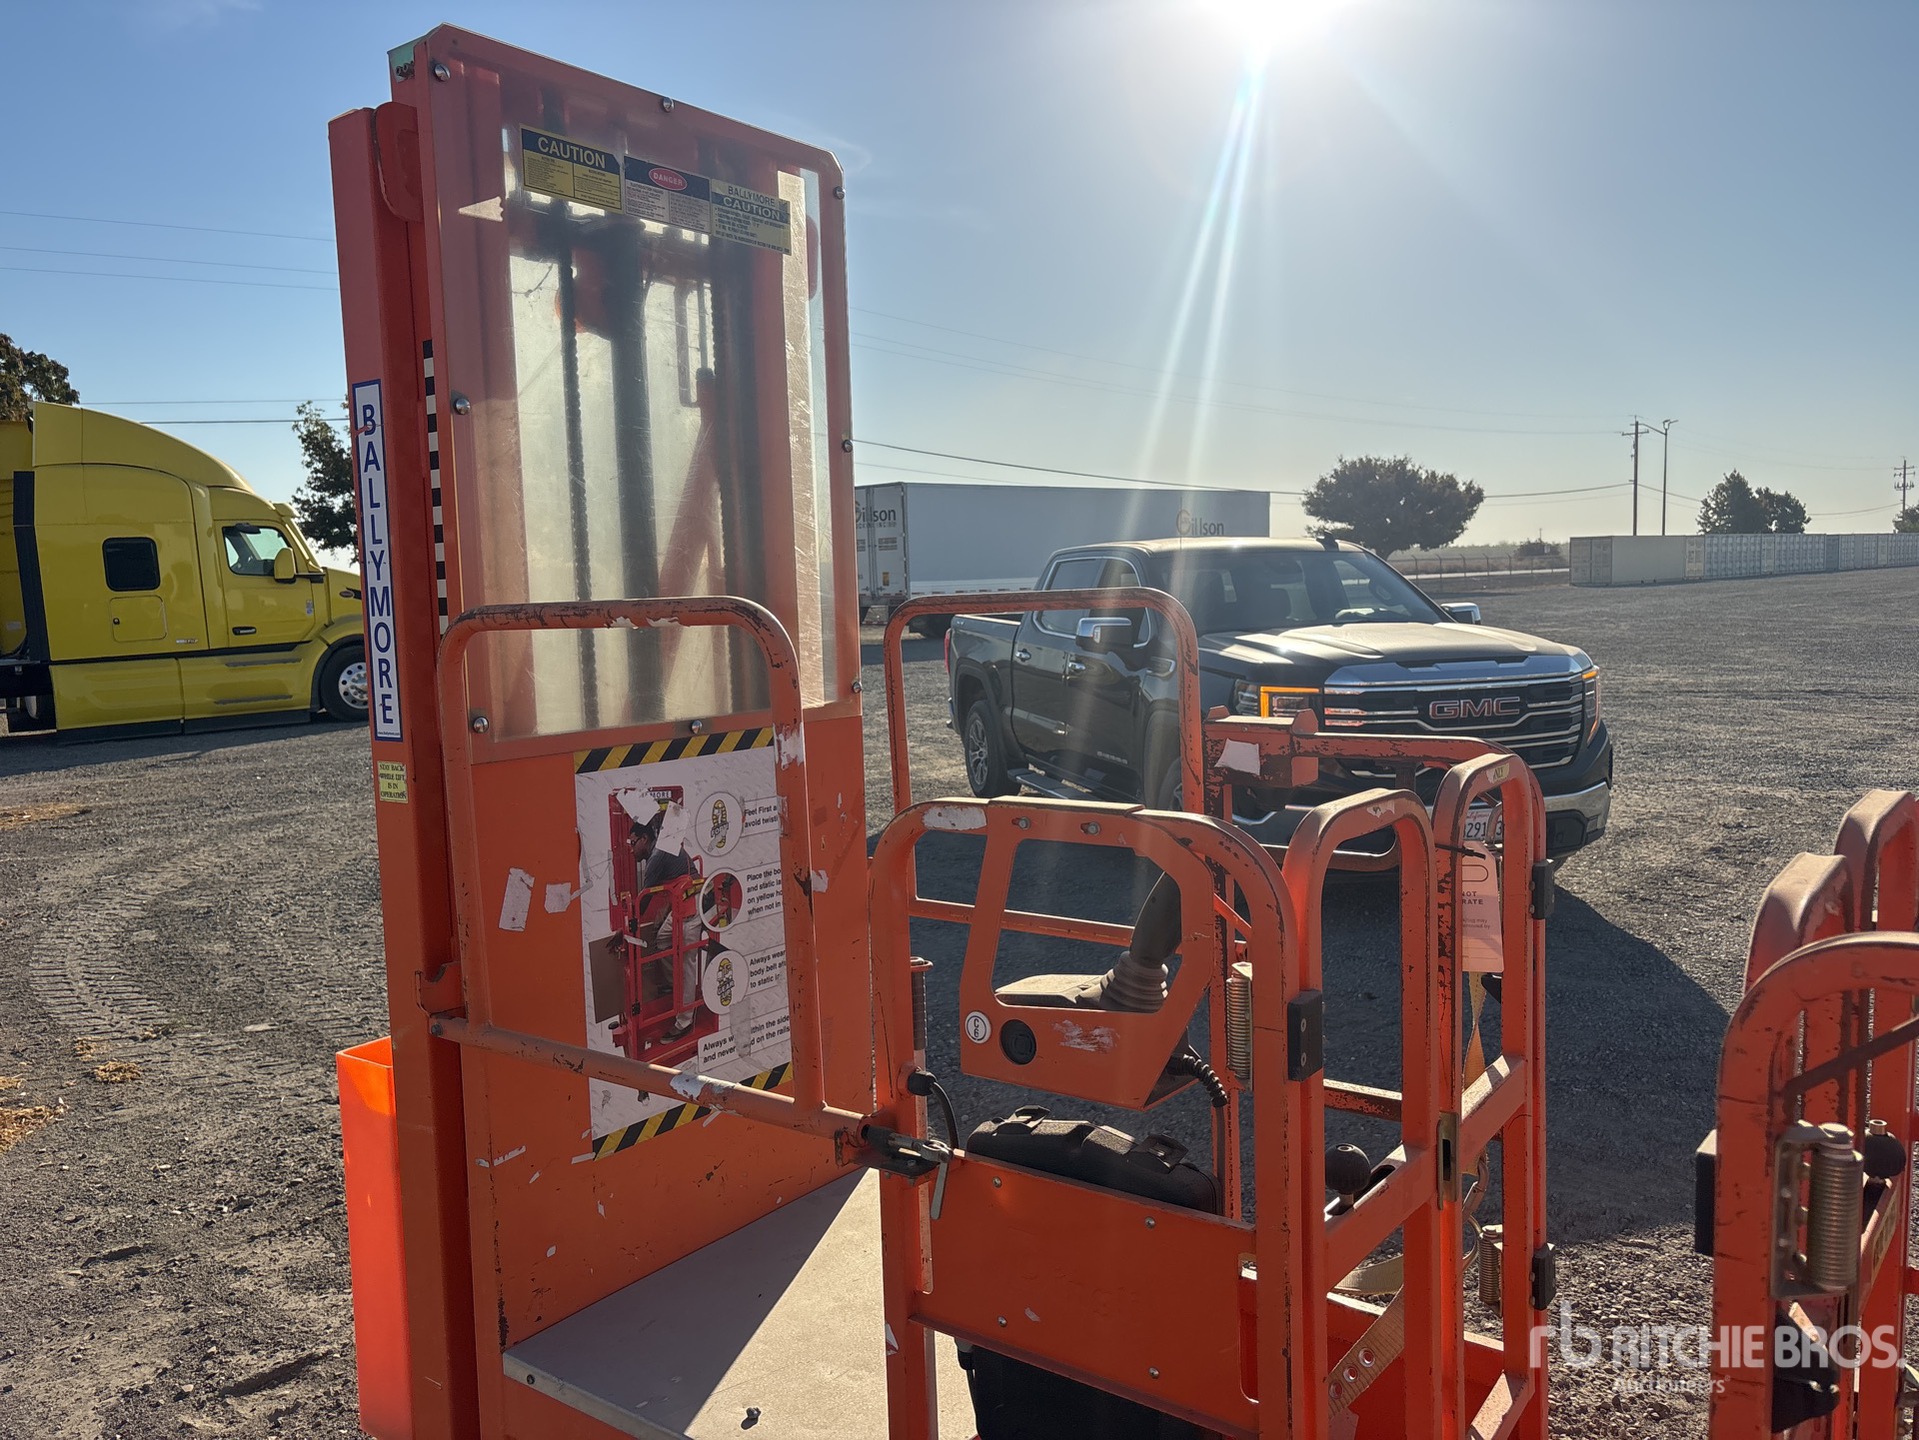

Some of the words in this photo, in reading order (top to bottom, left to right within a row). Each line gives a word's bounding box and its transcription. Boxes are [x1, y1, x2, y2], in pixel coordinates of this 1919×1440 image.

[537, 137, 606, 169] CAUTION
[653, 172, 683, 187] DANGER
[728, 186, 775, 207] BALLYMORE
[723, 197, 780, 221] CAUTION
[361, 404, 394, 724] BALLYMORE
[1429, 696, 1520, 719] GMC
[744, 808, 758, 817] Feet
[758, 805, 772, 814] First
[744, 818, 761, 828] avoid
[746, 873, 762, 882] Place
[747, 883, 758, 893] and
[759, 880, 775, 890] static
[756, 891, 775, 904] yellow
[747, 906, 764, 916] when
[764, 902, 774, 911] not
[749, 954, 771, 967] Always
[771, 950, 786, 959] wear
[750, 967, 764, 977] body
[766, 963, 777, 972] belt
[757, 975, 774, 986] static
[703, 1037, 728, 1052] Always
[765, 1020, 776, 1030] the
[703, 1053, 716, 1064] and
[717, 1046, 736, 1058] never
[765, 1031, 776, 1040] the
[777, 1025, 790, 1035] rails
